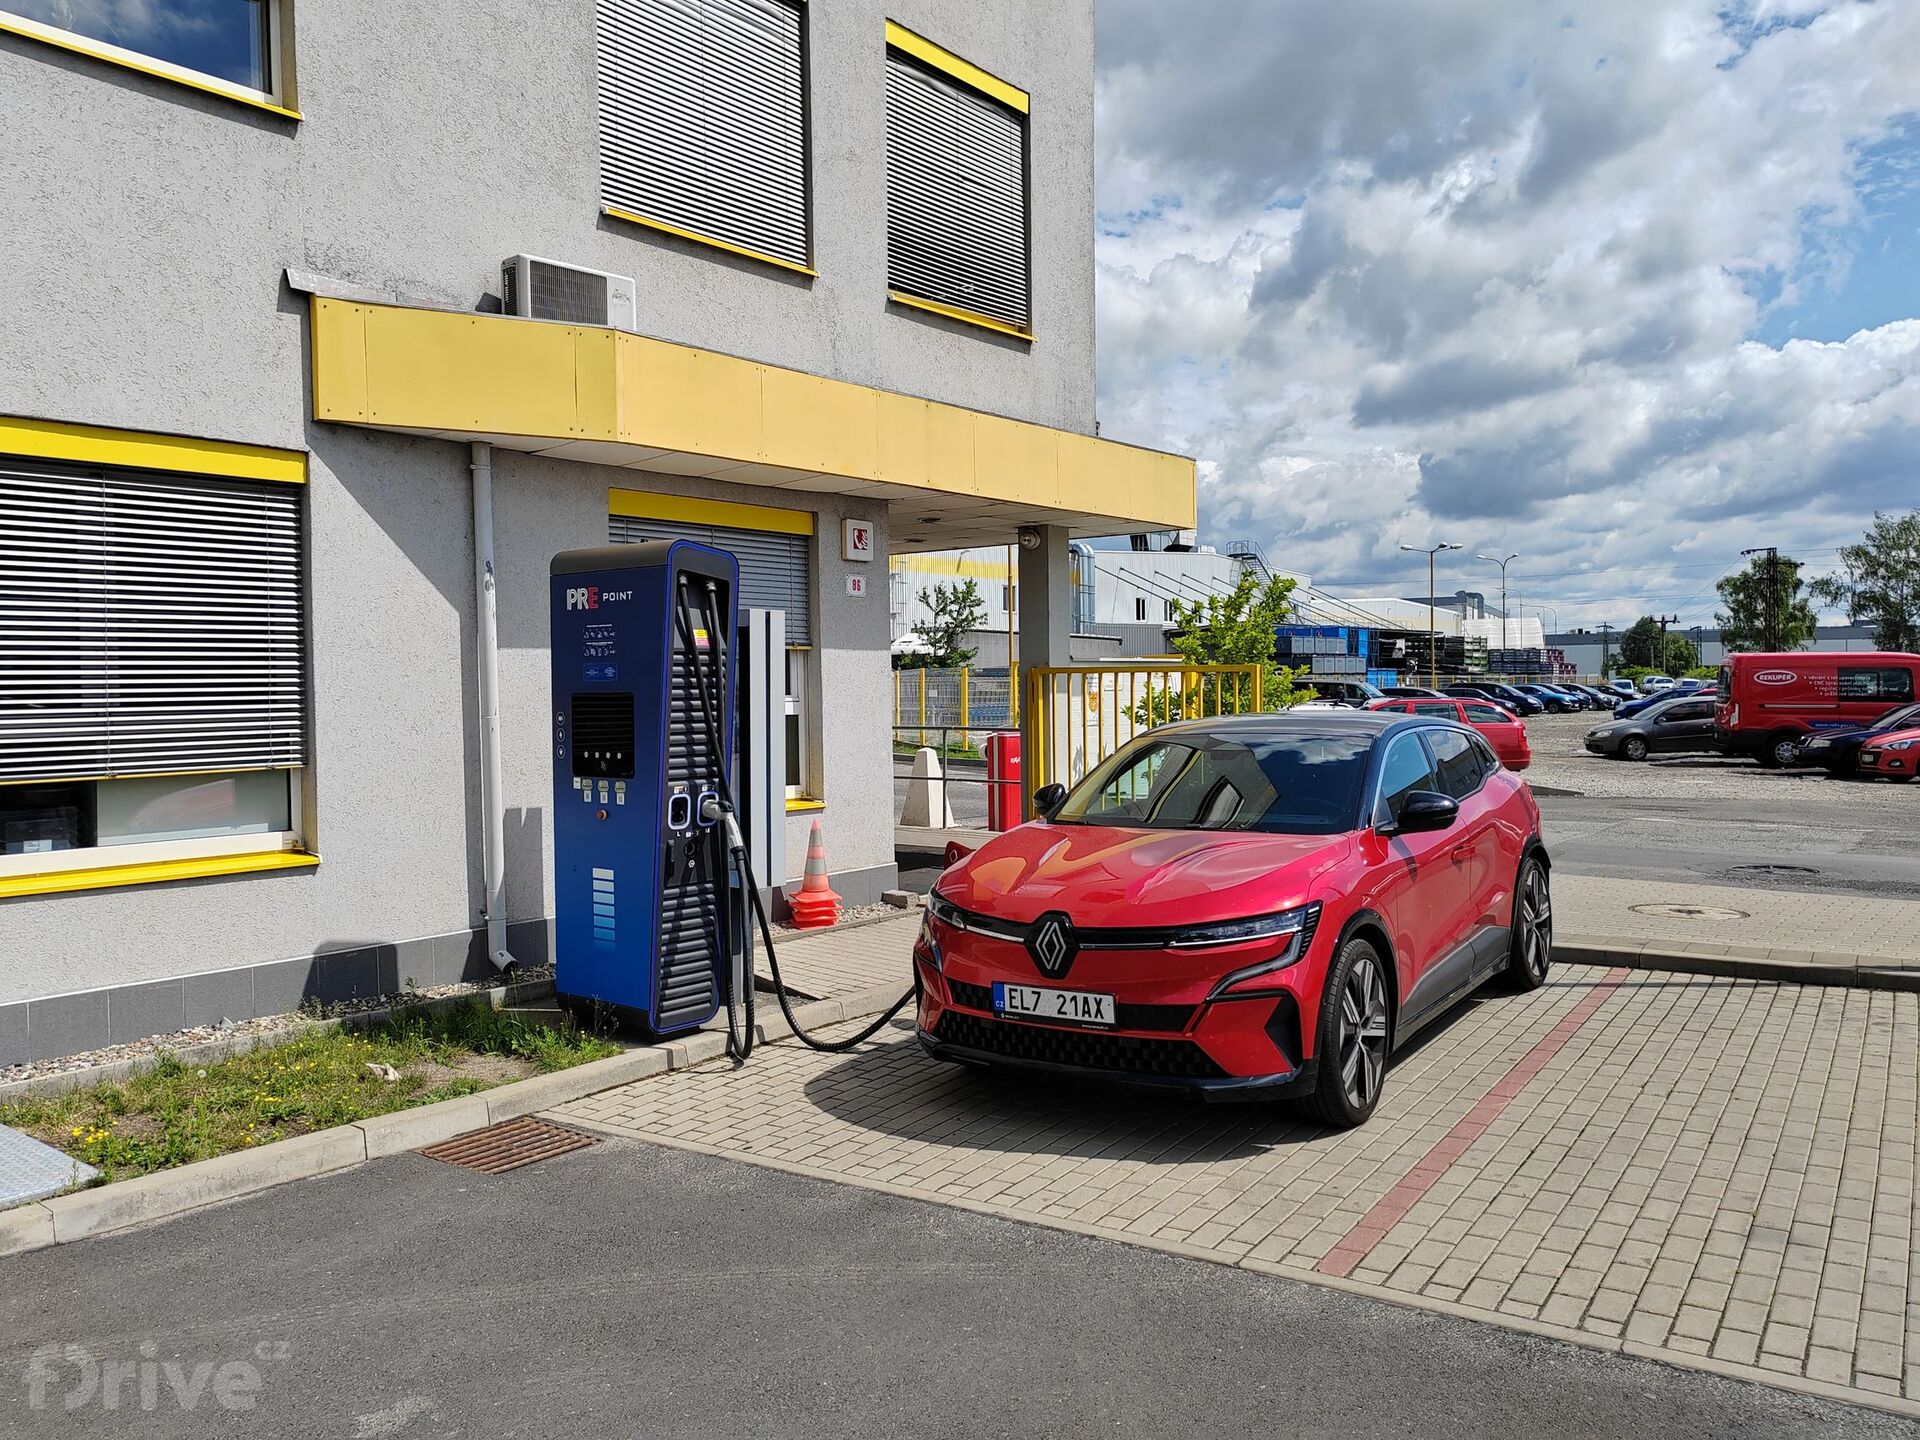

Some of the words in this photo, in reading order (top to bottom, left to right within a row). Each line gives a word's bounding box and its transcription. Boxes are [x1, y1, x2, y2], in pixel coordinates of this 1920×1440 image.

[852, 579, 861, 591] 86
[567, 587, 598, 610] PRE
[603, 591, 632, 602] POINT
[995, 1000, 1004, 1008] CZ
[1008, 987, 1041, 1012] EL7
[1056, 993, 1104, 1019] 21AX
